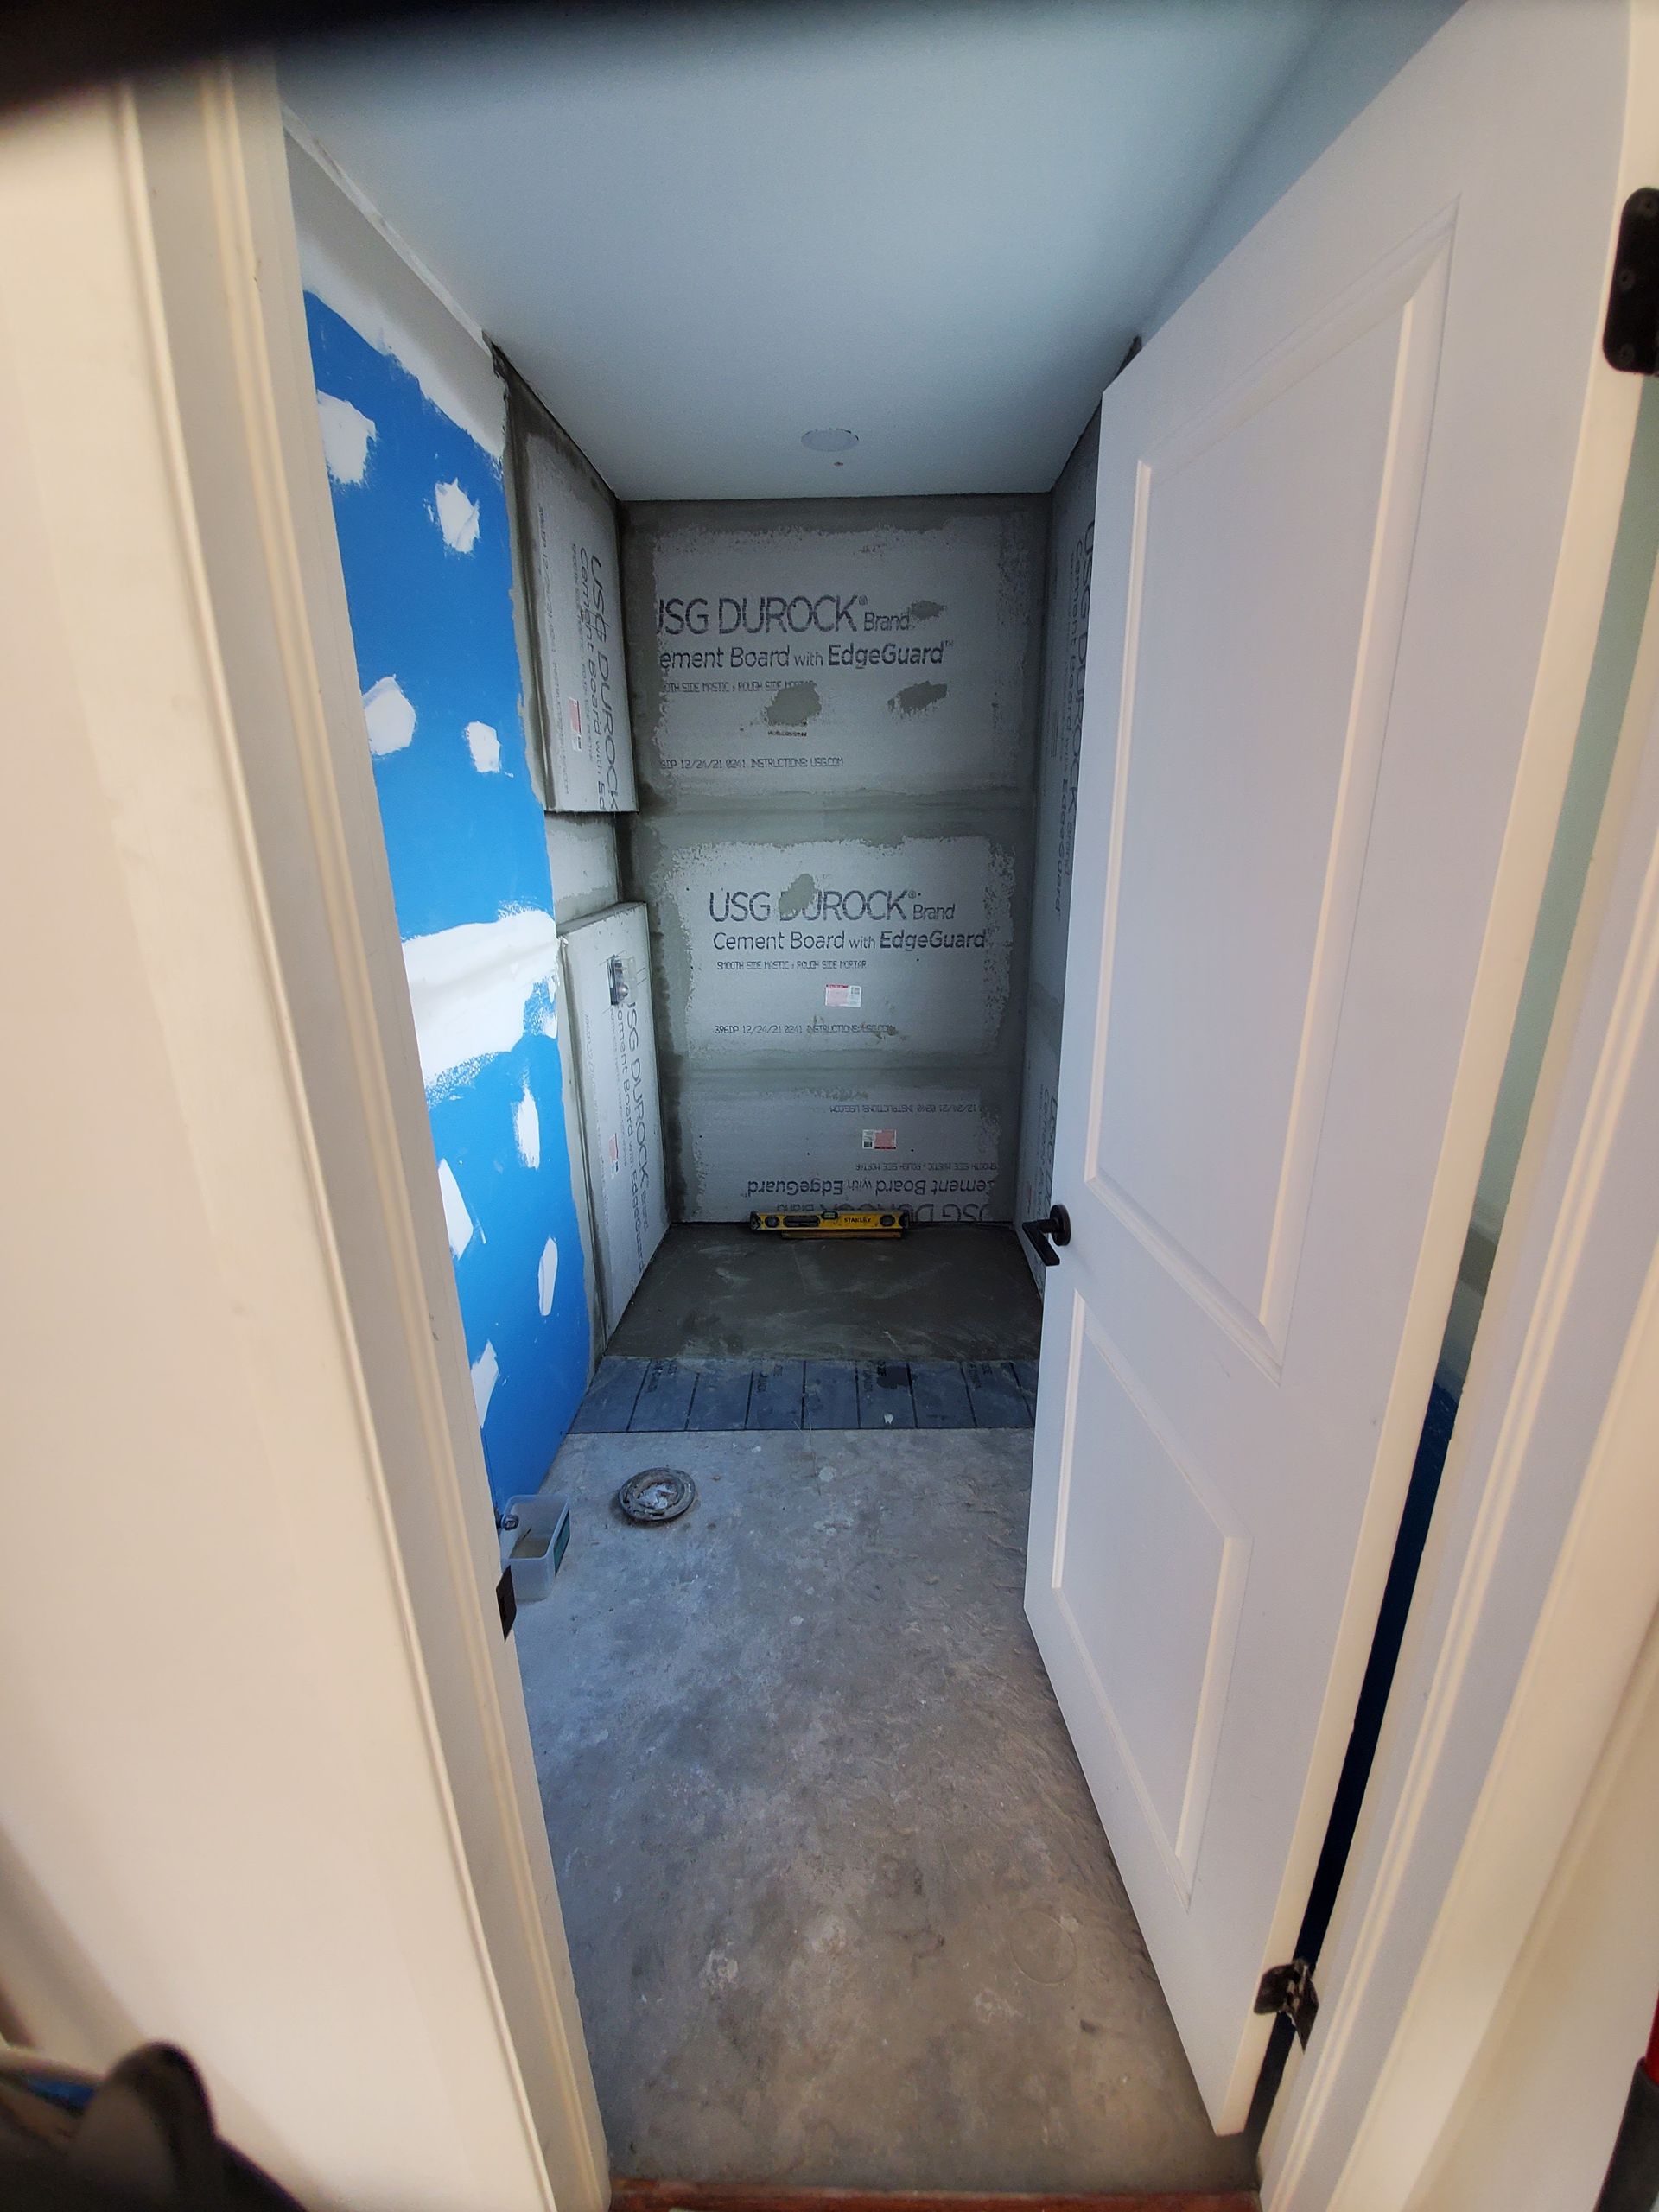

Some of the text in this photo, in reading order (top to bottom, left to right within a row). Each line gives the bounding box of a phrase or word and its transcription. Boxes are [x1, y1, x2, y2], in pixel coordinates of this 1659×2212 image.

[862, 611, 910, 632] Brand
[659, 646, 724, 669] ement
[729, 645, 790, 669] Board
[793, 652, 823, 668] with
[590, 555, 619, 810] USG DUROCK
[588, 658, 602, 735] Board
[709, 891, 771, 922] USG
[912, 904, 957, 921] Brand
[712, 931, 785, 950] Cement
[790, 931, 845, 950] Board
[849, 936, 876, 950] with
[623, 1078, 634, 1137] Board
[875, 1179, 927, 1197] Board
